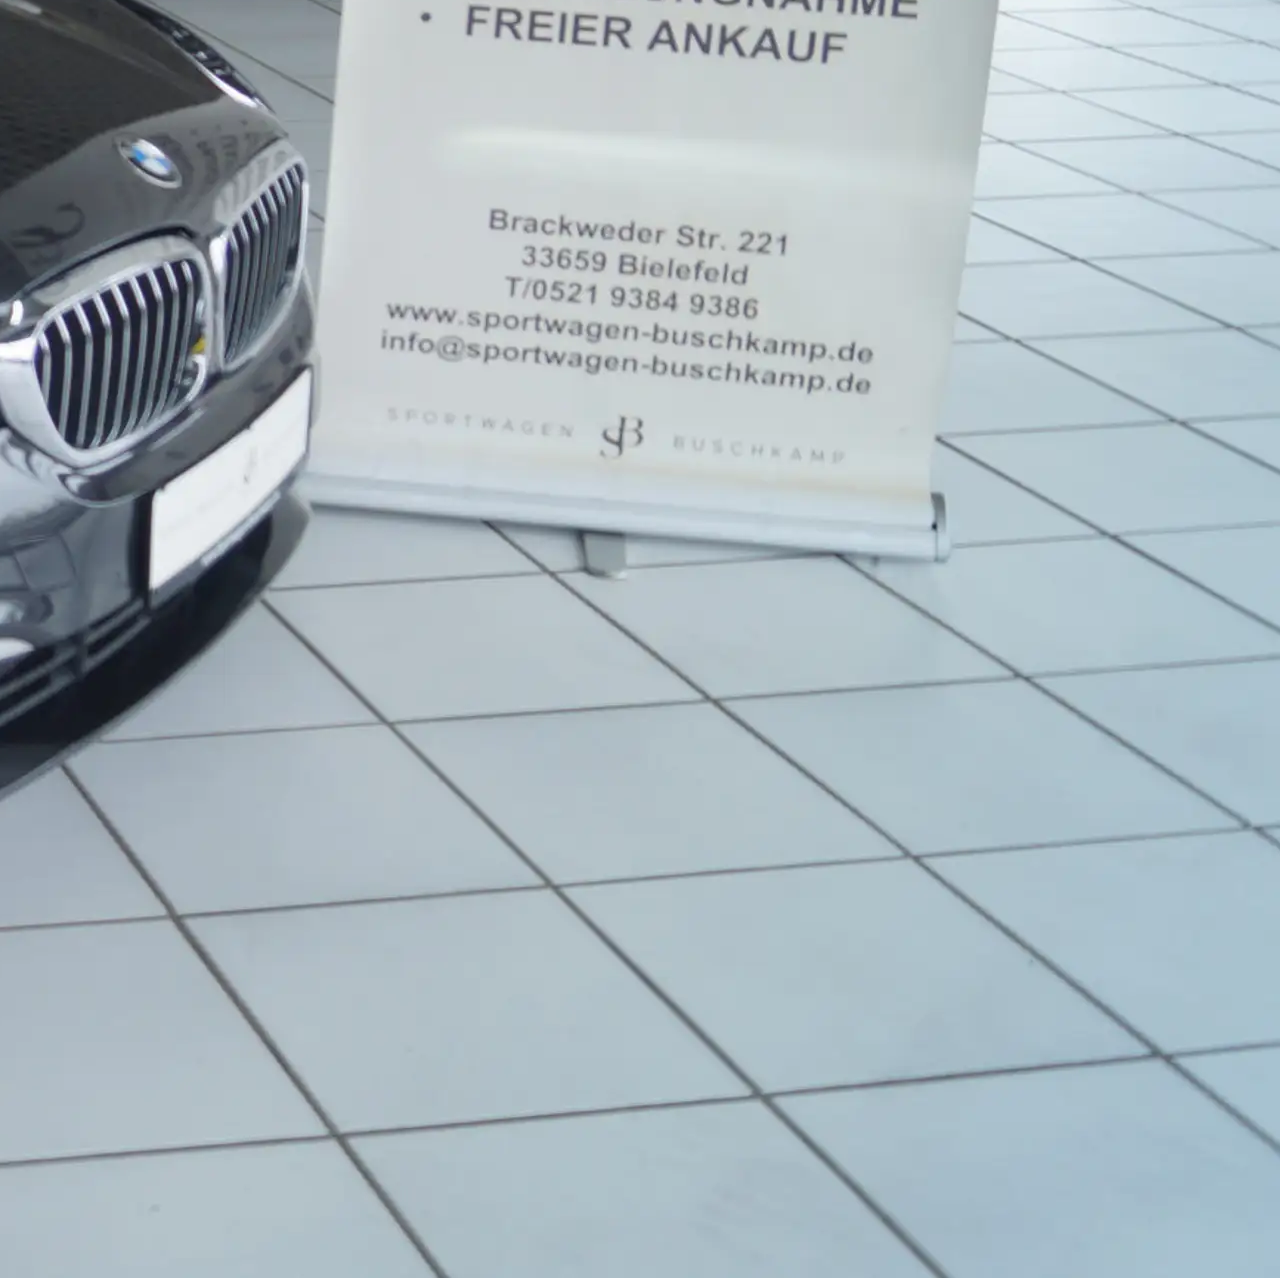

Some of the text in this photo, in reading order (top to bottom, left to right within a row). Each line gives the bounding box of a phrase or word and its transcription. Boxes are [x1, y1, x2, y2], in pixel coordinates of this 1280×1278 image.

[465, 3, 848, 65] FREIER ANKAUF
[488, 208, 788, 257] Brackweder Str. 221
[521, 244, 750, 287] 33659 Bielefeld
[505, 275, 759, 321] T/0521 9384 9386
[380, 329, 872, 396] info@sportwagen-buschkamp.de
[386, 303, 874, 365] www.sportwagen-buschkamp.de
[386, 407, 576, 440] SPORTWAGEN
[672, 433, 847, 465] BUSCHKAMP
